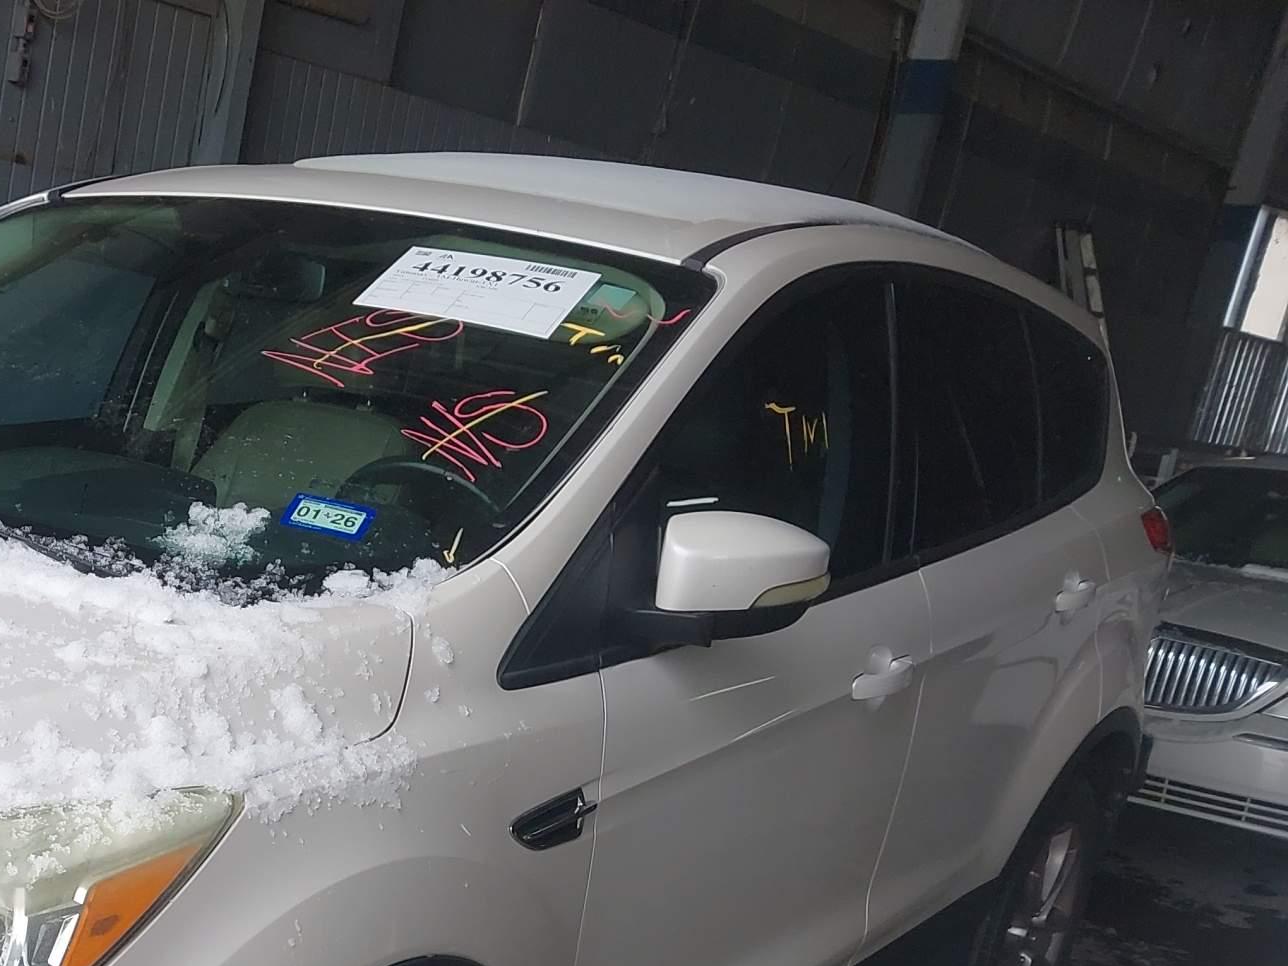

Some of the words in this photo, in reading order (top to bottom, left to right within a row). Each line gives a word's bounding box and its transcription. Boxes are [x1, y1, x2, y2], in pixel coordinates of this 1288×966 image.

[412, 261, 563, 293] 44198756
[296, 506, 321, 520] 01
[330, 513, 358, 528] 26
